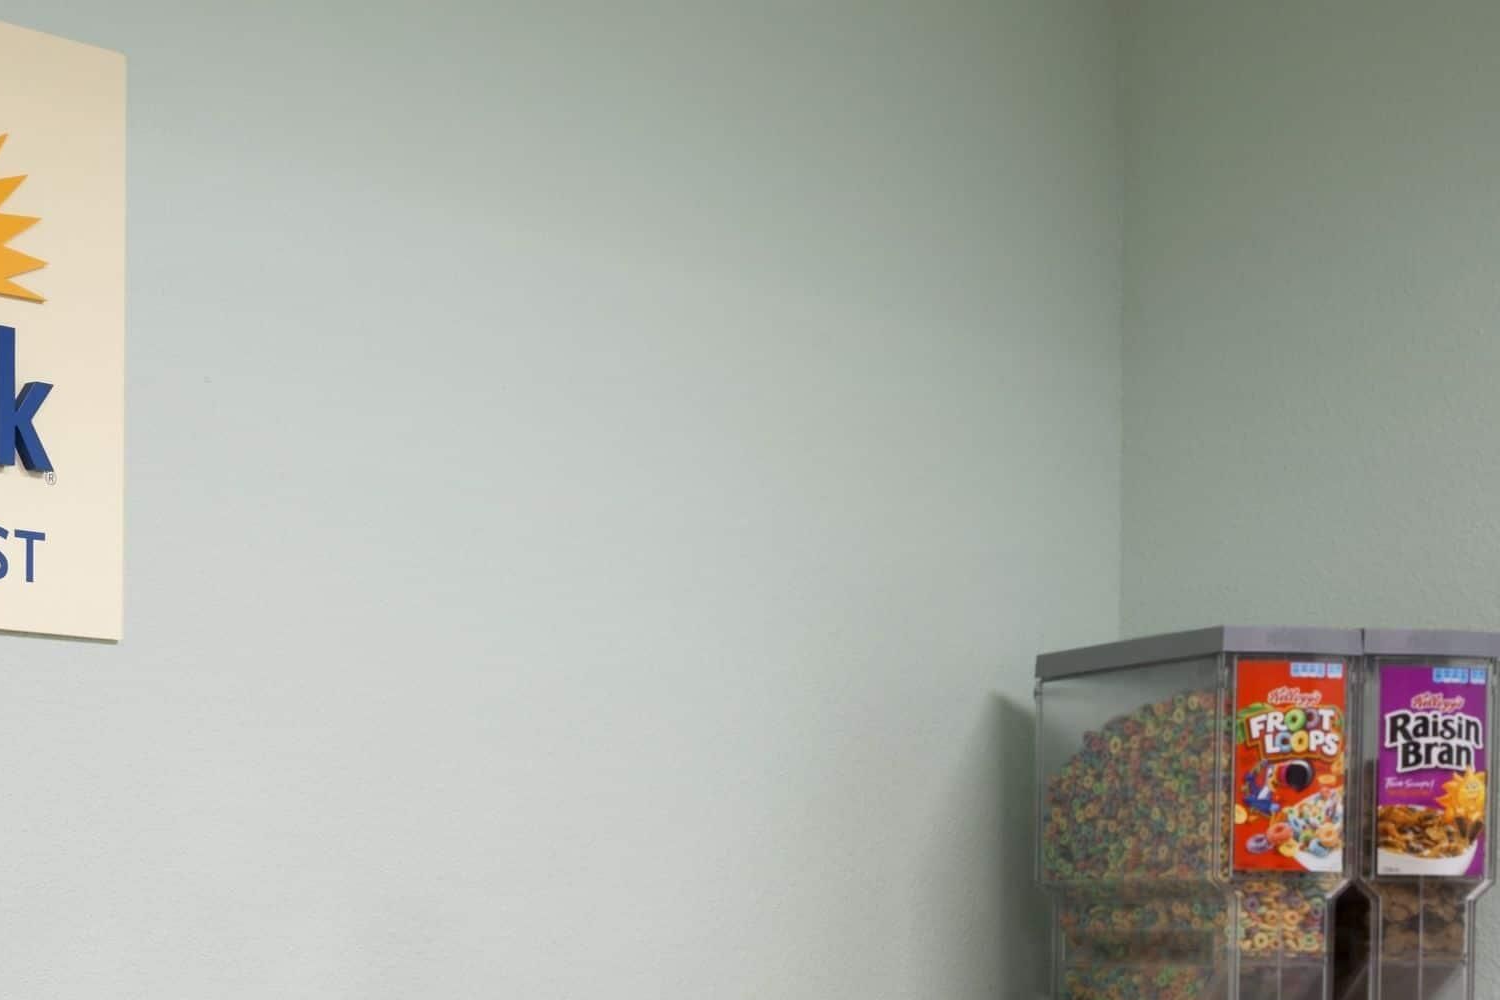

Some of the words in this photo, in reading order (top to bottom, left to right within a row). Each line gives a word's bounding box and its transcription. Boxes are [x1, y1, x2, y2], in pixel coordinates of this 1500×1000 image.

[1249, 708, 1336, 739] FROOT
[1387, 711, 1481, 747] Raisin
[1264, 730, 1340, 756] LOOPS
[1401, 740, 1472, 770] Bran
